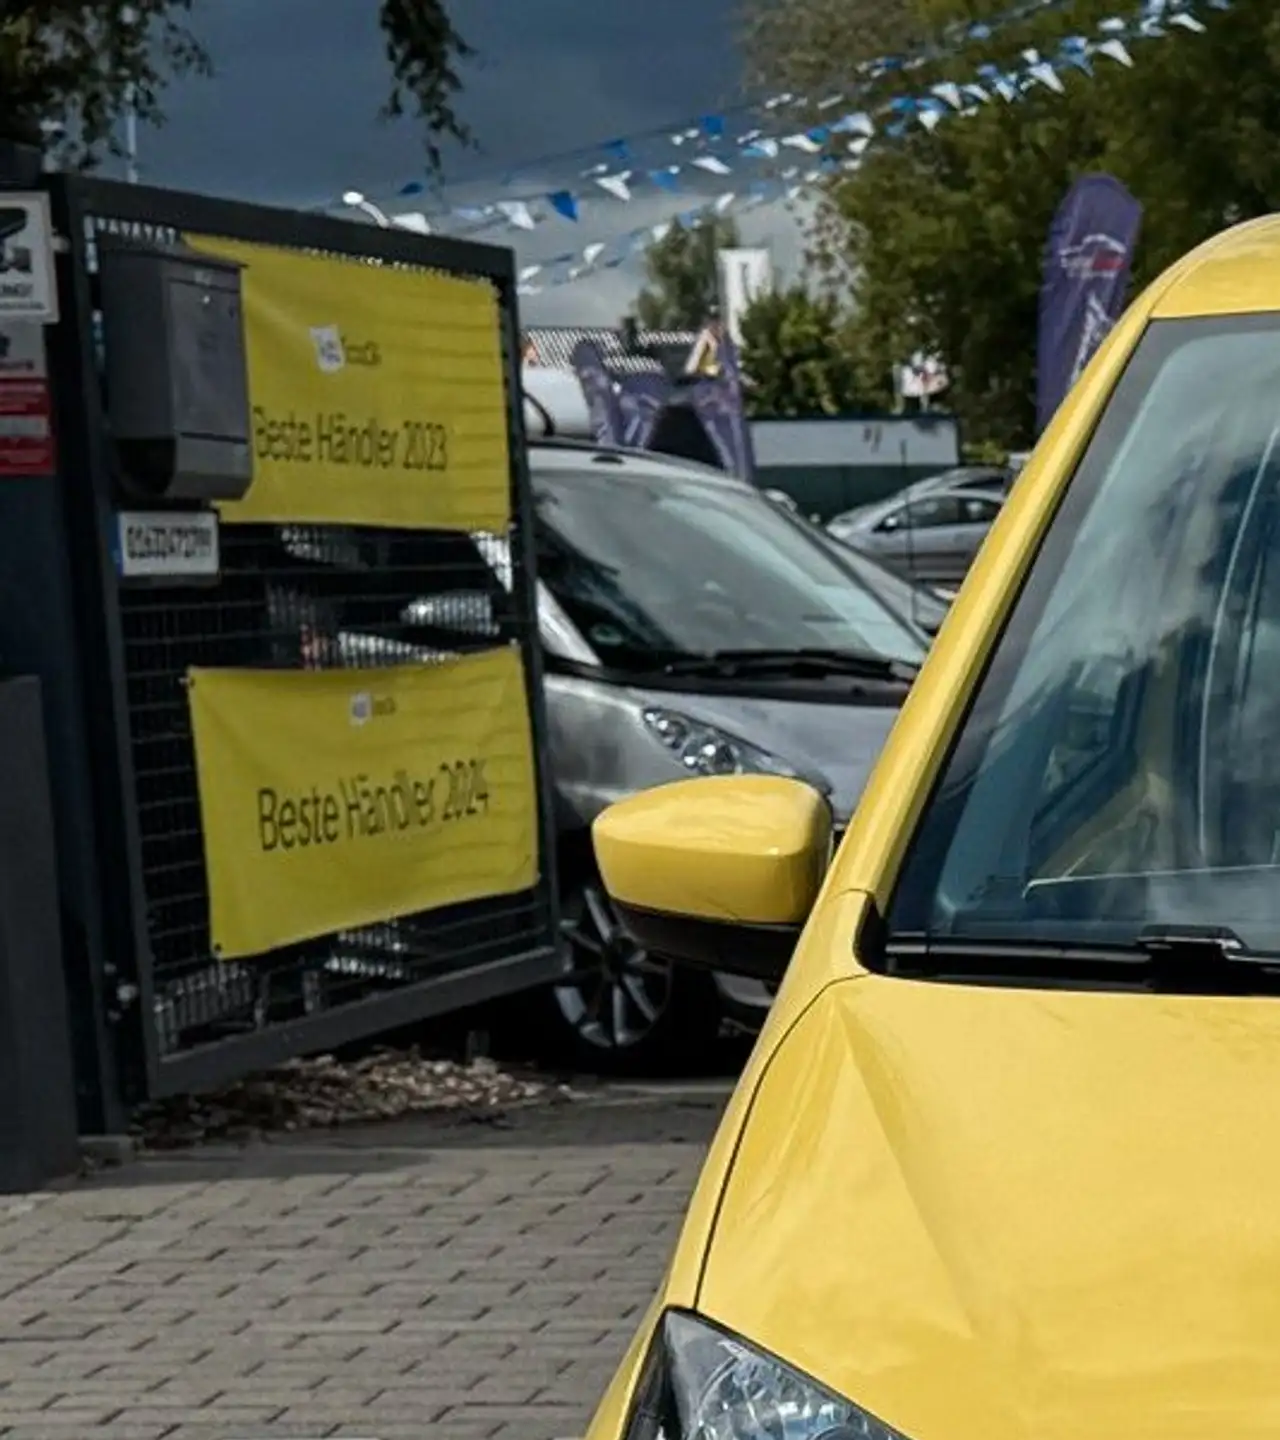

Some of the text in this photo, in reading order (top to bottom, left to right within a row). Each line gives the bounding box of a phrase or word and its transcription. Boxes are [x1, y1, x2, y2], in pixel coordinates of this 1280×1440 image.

[253, 405, 311, 462] Beste
[316, 411, 399, 469] Händler
[257, 759, 489, 852] Beste Händler 2024
